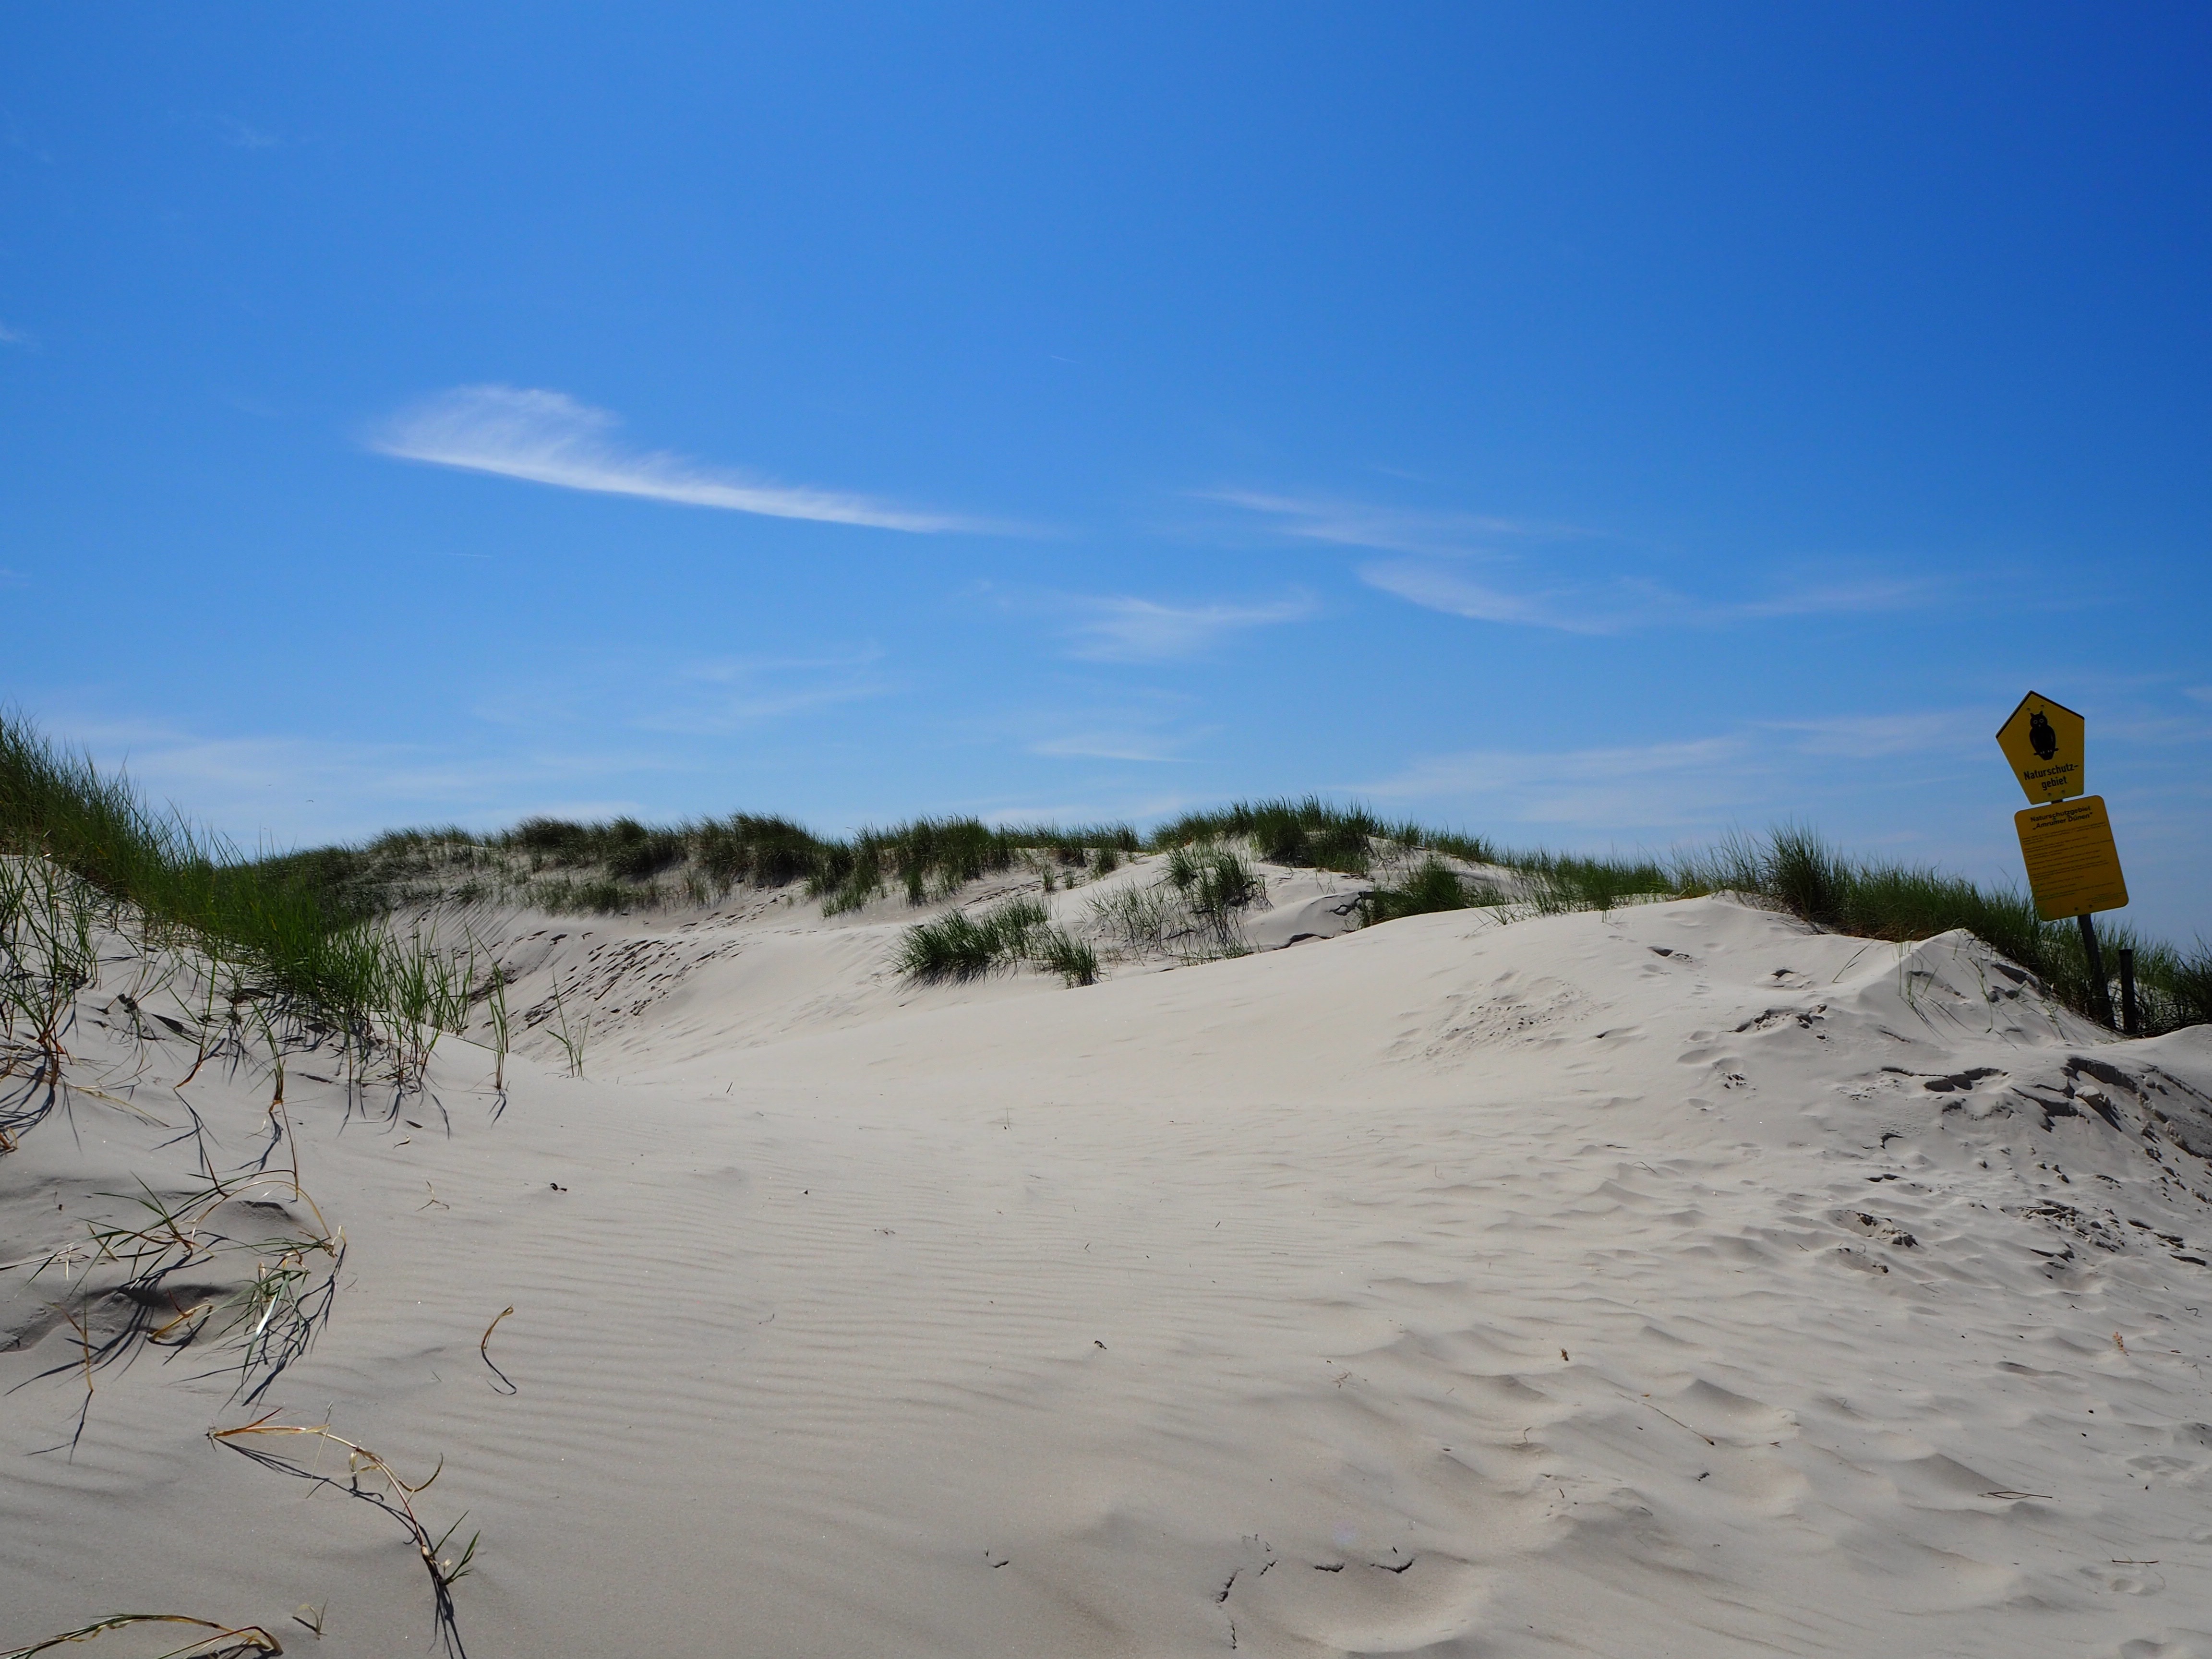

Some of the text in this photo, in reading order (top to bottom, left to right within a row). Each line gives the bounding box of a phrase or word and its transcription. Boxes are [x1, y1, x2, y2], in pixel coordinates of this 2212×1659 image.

[2024, 764, 2079, 780] Naturschutz-
[2042, 776, 2067, 791] gebiet
[2031, 806, 2091, 822] Naturschutzgebiet
